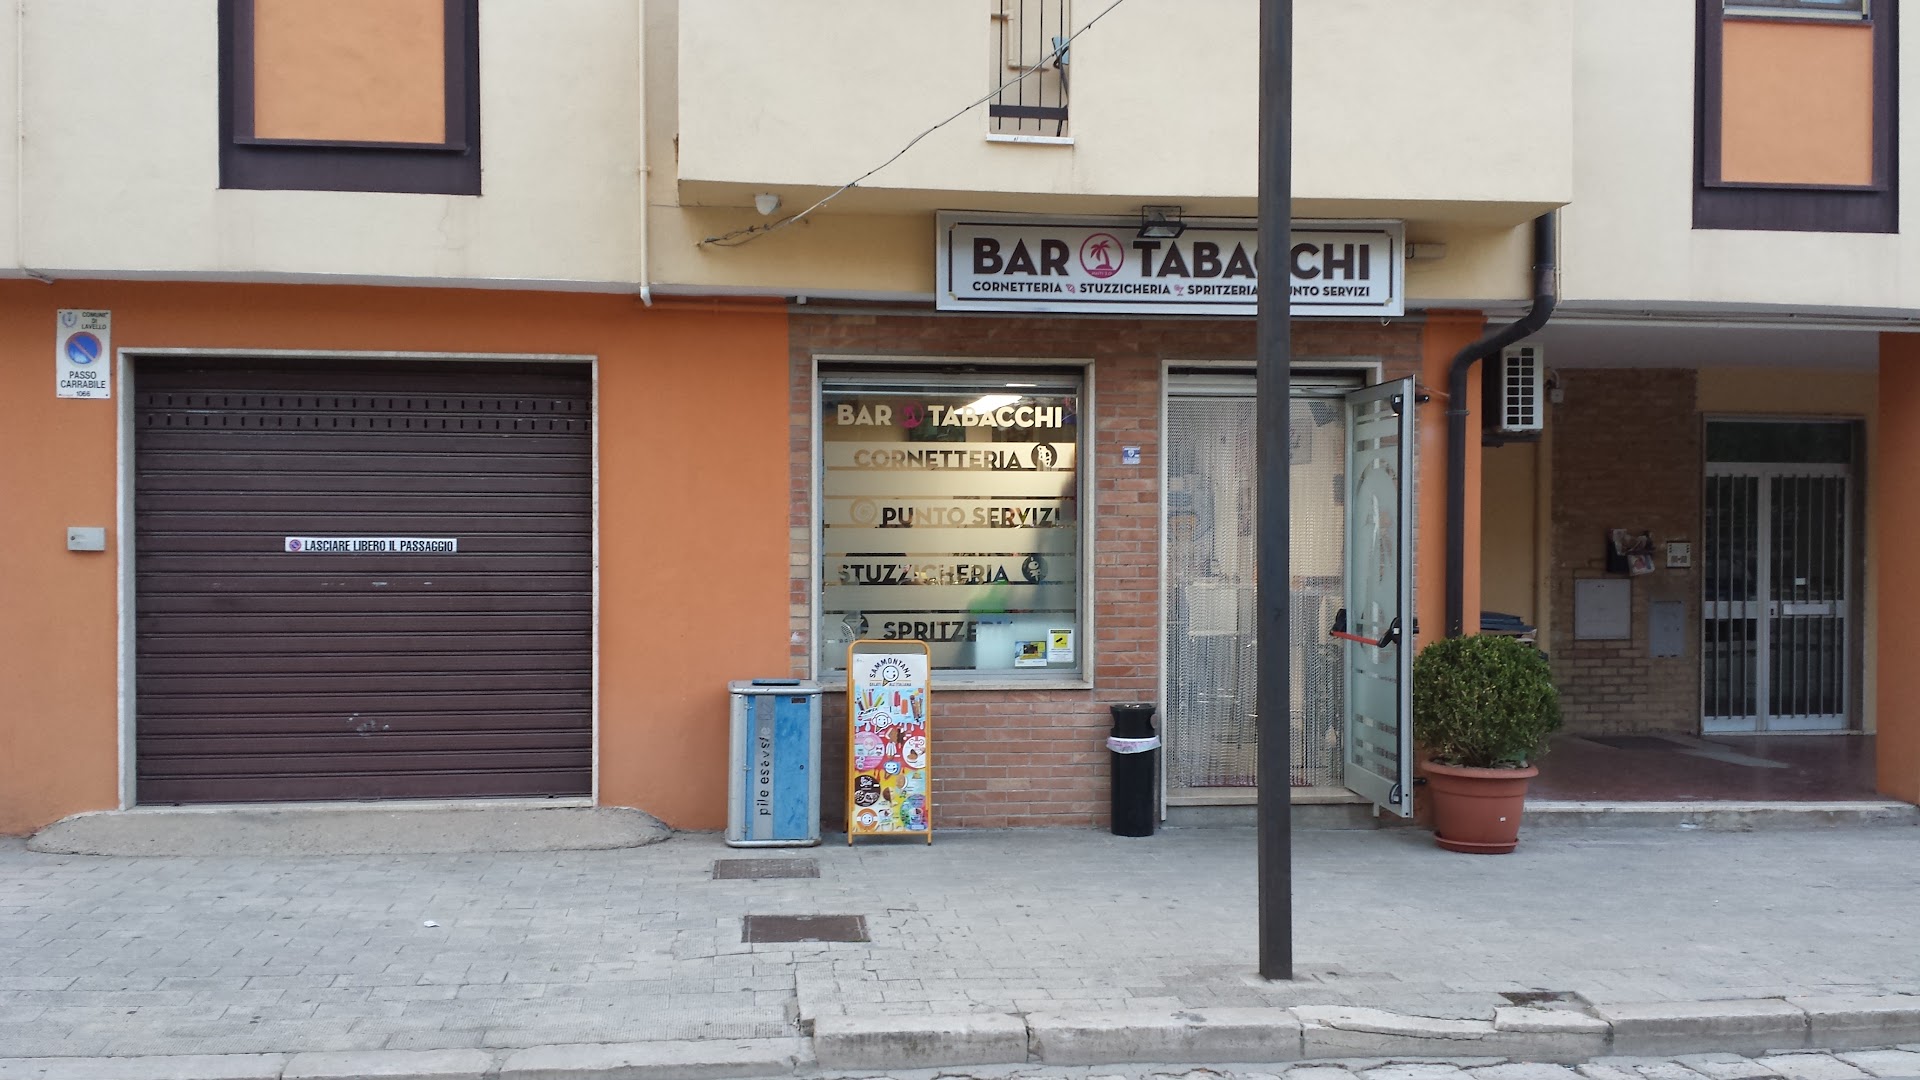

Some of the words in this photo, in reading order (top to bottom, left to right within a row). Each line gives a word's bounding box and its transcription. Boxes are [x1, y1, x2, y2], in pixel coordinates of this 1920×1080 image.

[973, 237, 1069, 277] BAR
[1133, 240, 1370, 280] TABACHI
[972, 281, 1062, 293] CORNETTERIA
[1080, 283, 1171, 295] STUZZICHERIA
[1322, 286, 1370, 297] SERVIZI
[60, 380, 106, 389] CARRABILE
[69, 371, 97, 380] PASSO
[837, 404, 893, 426] BAR
[927, 405, 1063, 428] TABACCHI
[853, 449, 1023, 469] CORNETTERIA
[882, 507, 966, 526] PUNTO
[972, 507, 1060, 527] SERVIZI
[304, 540, 351, 551] LASCIARE
[353, 540, 386, 551] LIBERO
[388, 541, 397, 551] IL
[400, 541, 454, 552] PASSAGGIO
[837, 564, 1009, 584] STUZZICHERIA
[883, 621, 1014, 641] SPRITZE
[869, 657, 912, 679] SAMMONTANA
[757, 789, 772, 816] pile
